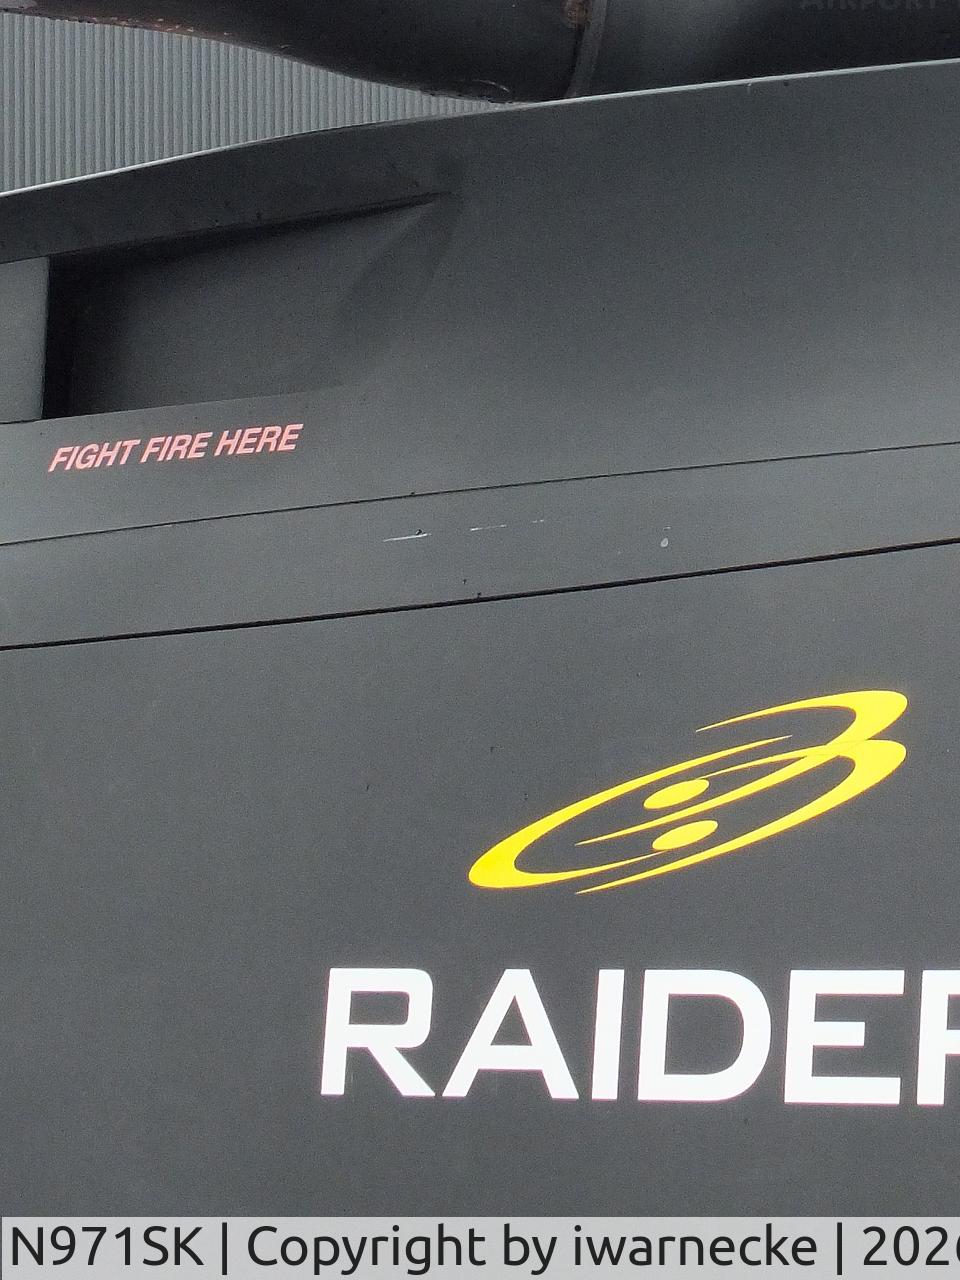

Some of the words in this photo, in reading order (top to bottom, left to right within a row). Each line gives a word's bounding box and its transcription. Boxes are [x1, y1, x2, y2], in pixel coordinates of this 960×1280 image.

[48, 439, 140, 472] FIGHT
[140, 431, 213, 463] FIRE
[214, 423, 303, 456] HERE
